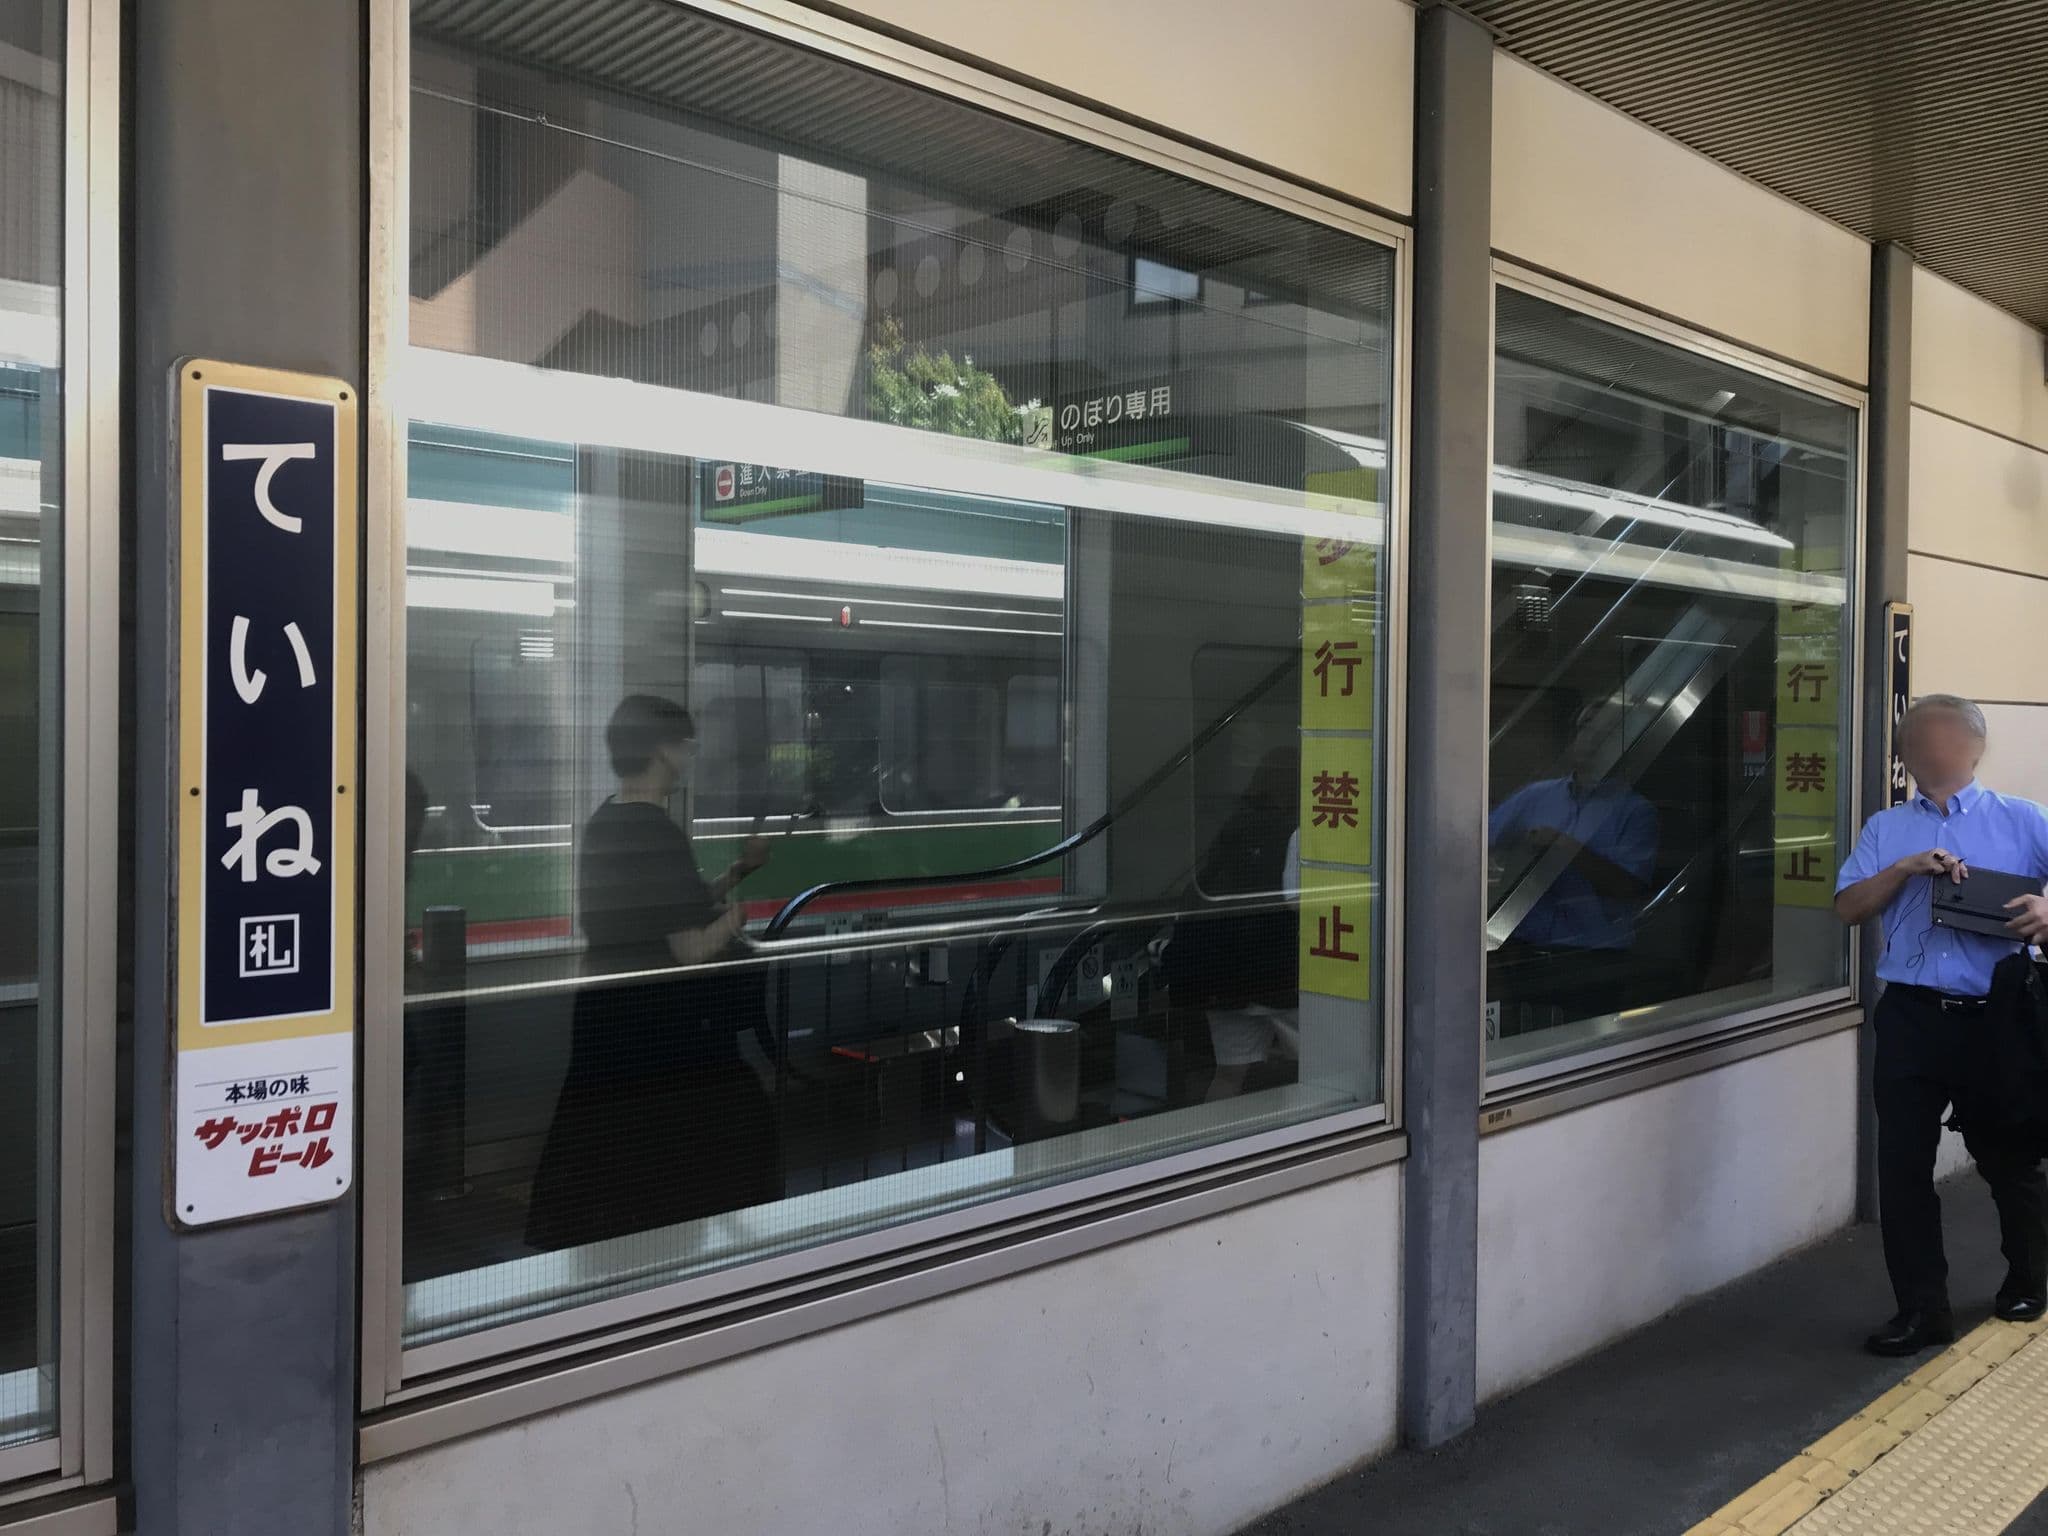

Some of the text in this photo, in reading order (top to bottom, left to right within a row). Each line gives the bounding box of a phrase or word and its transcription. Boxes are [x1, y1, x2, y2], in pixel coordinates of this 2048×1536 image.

[1060, 385, 1171, 431] のぼり専用
[1061, 432, 1096, 448] Up Only
[221, 442, 323, 974] ていね 札
[1783, 585, 1829, 882] 行禁止
[225, 1074, 310, 1104] 本場の味
[194, 1102, 338, 1150] サッポロ
[248, 1137, 334, 1178] ビール
